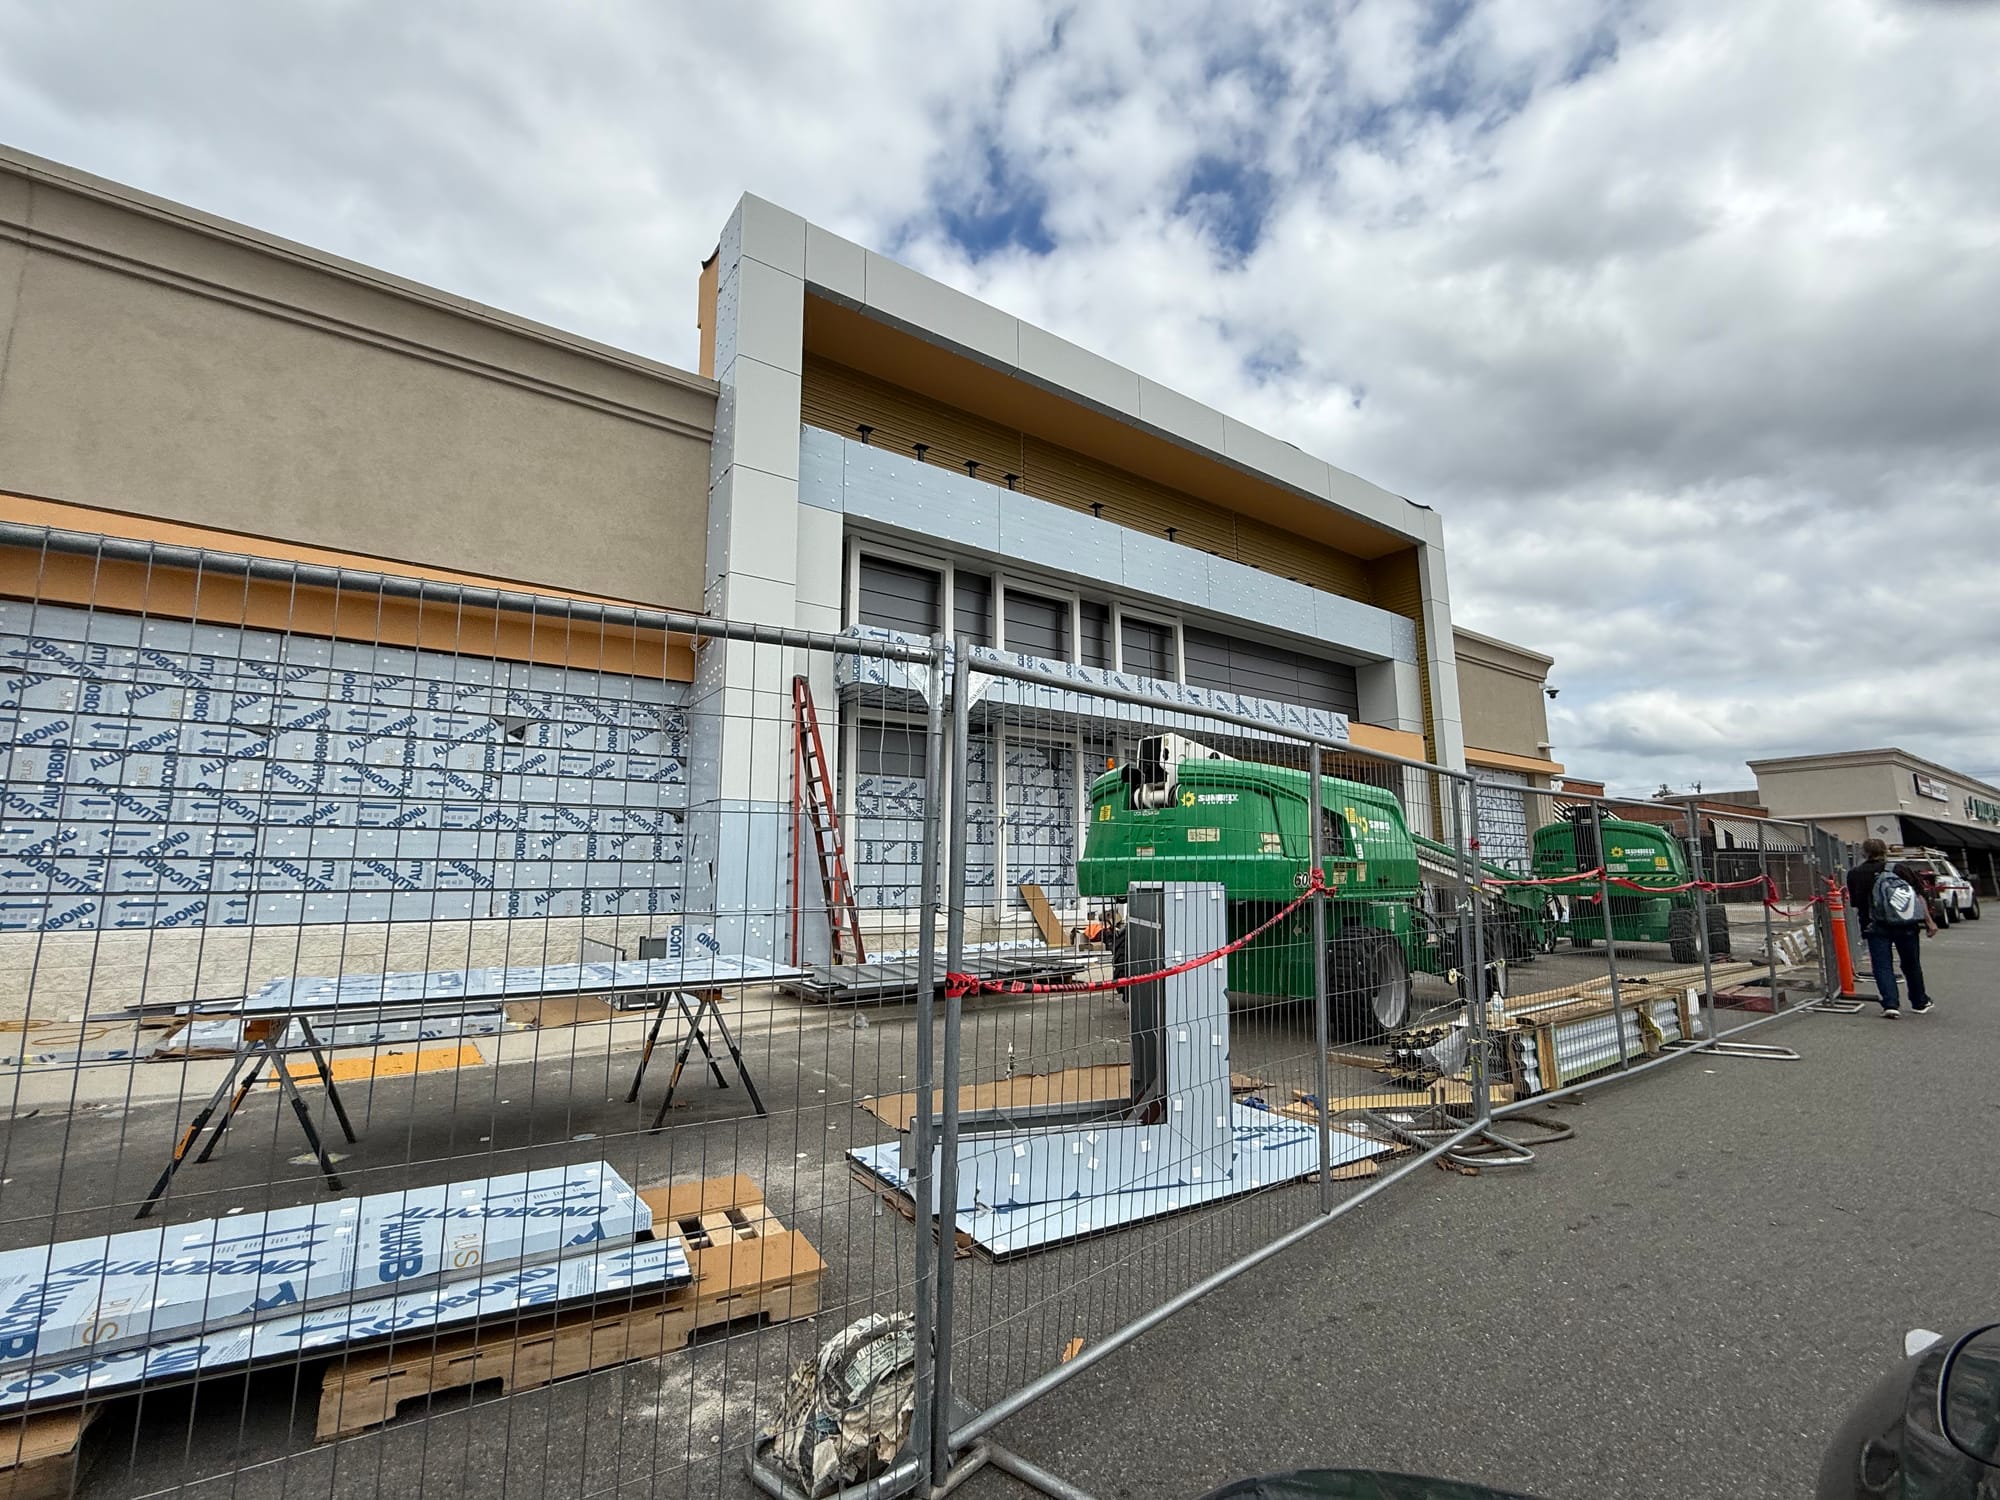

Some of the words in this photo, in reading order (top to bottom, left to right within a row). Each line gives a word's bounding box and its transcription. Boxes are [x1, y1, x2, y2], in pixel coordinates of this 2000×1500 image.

[232, 694, 263, 710] ALU
[384, 1205, 609, 1219] ALUCOBOND
[50, 1259, 317, 1276] ALUCOBOND
